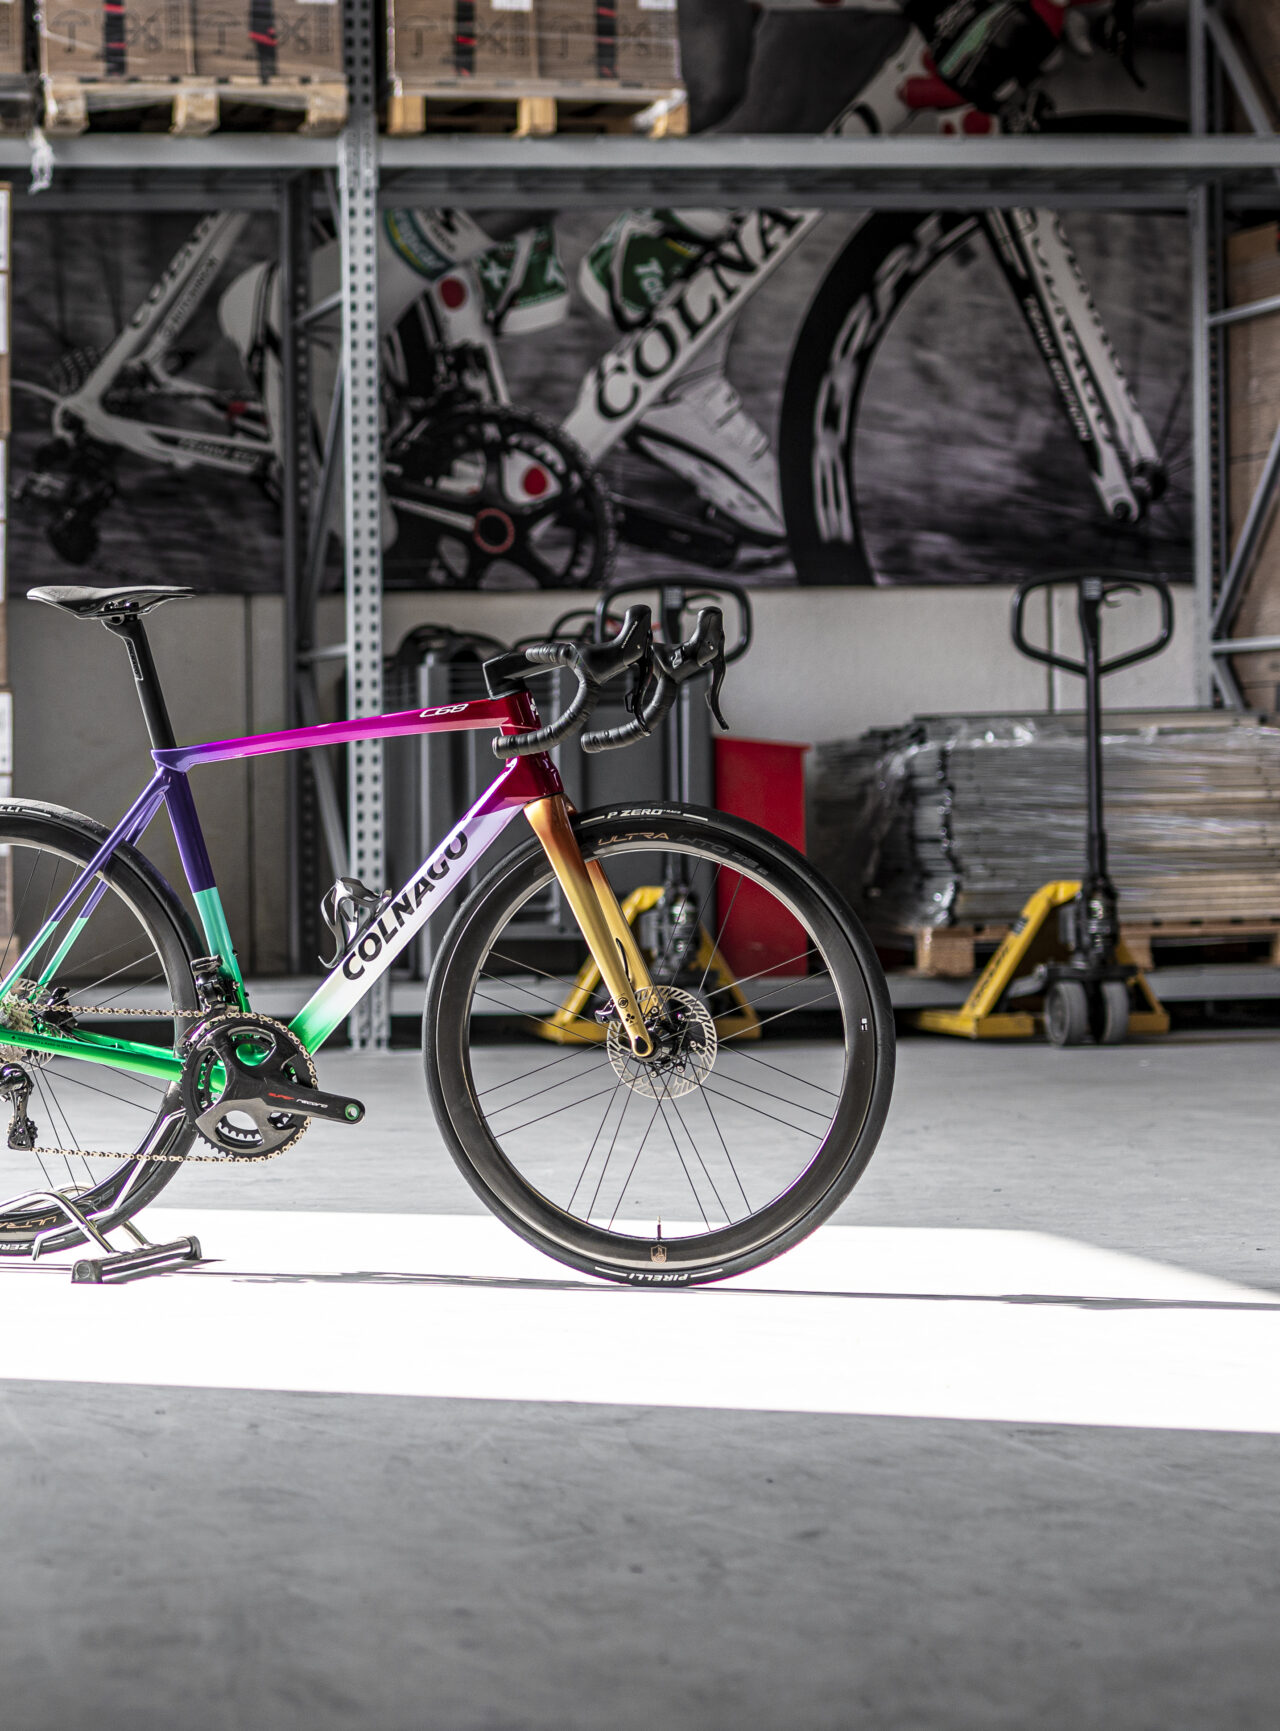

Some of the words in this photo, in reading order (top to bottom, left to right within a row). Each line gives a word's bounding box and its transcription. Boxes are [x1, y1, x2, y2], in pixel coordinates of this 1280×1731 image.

[597, 209, 805, 421] COLNA
[607, 811, 618, 819] P
[619, 808, 664, 817] ZERO
[598, 832, 669, 846] ULTRA
[342, 830, 468, 981] COLNAGO
[628, 1273, 689, 1282] PIRELLI
